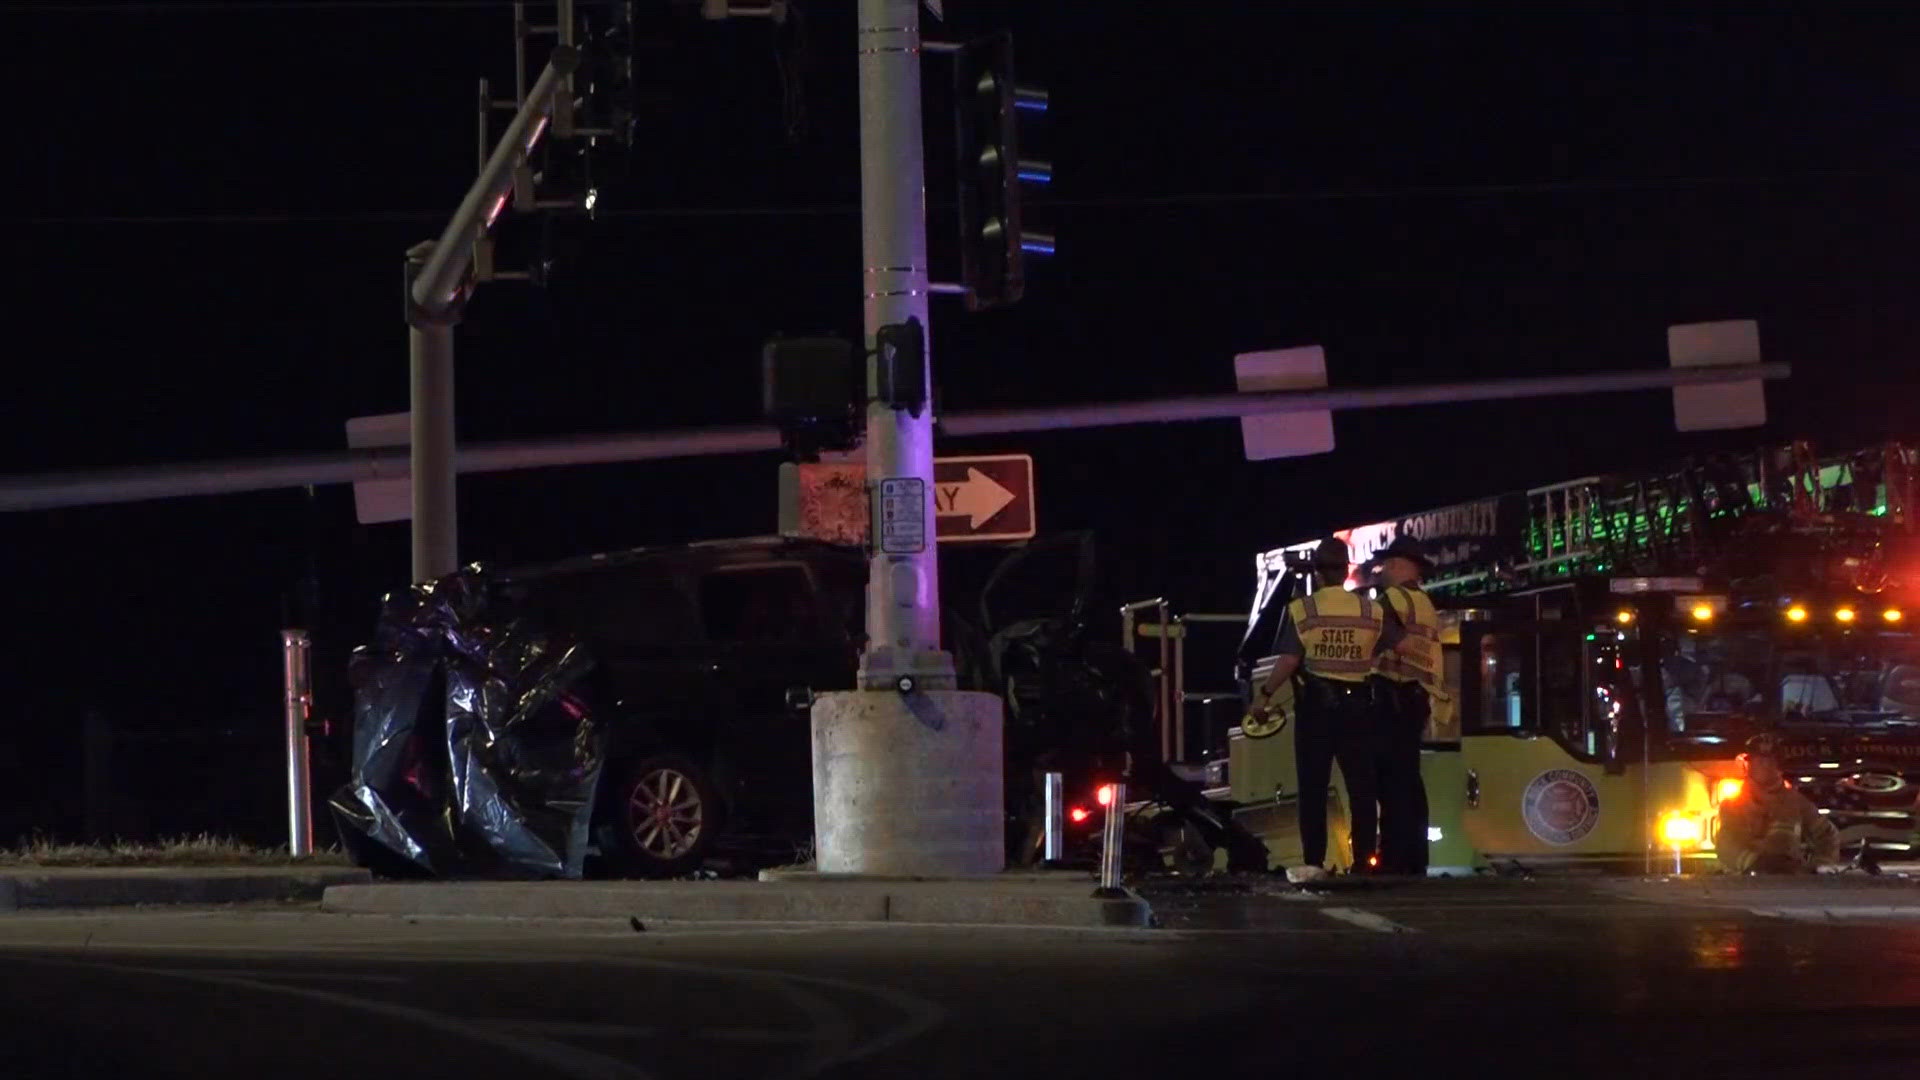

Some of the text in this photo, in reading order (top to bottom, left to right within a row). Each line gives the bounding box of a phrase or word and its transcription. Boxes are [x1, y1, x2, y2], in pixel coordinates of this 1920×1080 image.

[1402, 500, 1499, 542] COMMUNITY
[1321, 629, 1355, 644] STATE
[1313, 643, 1363, 660] TROOPER
